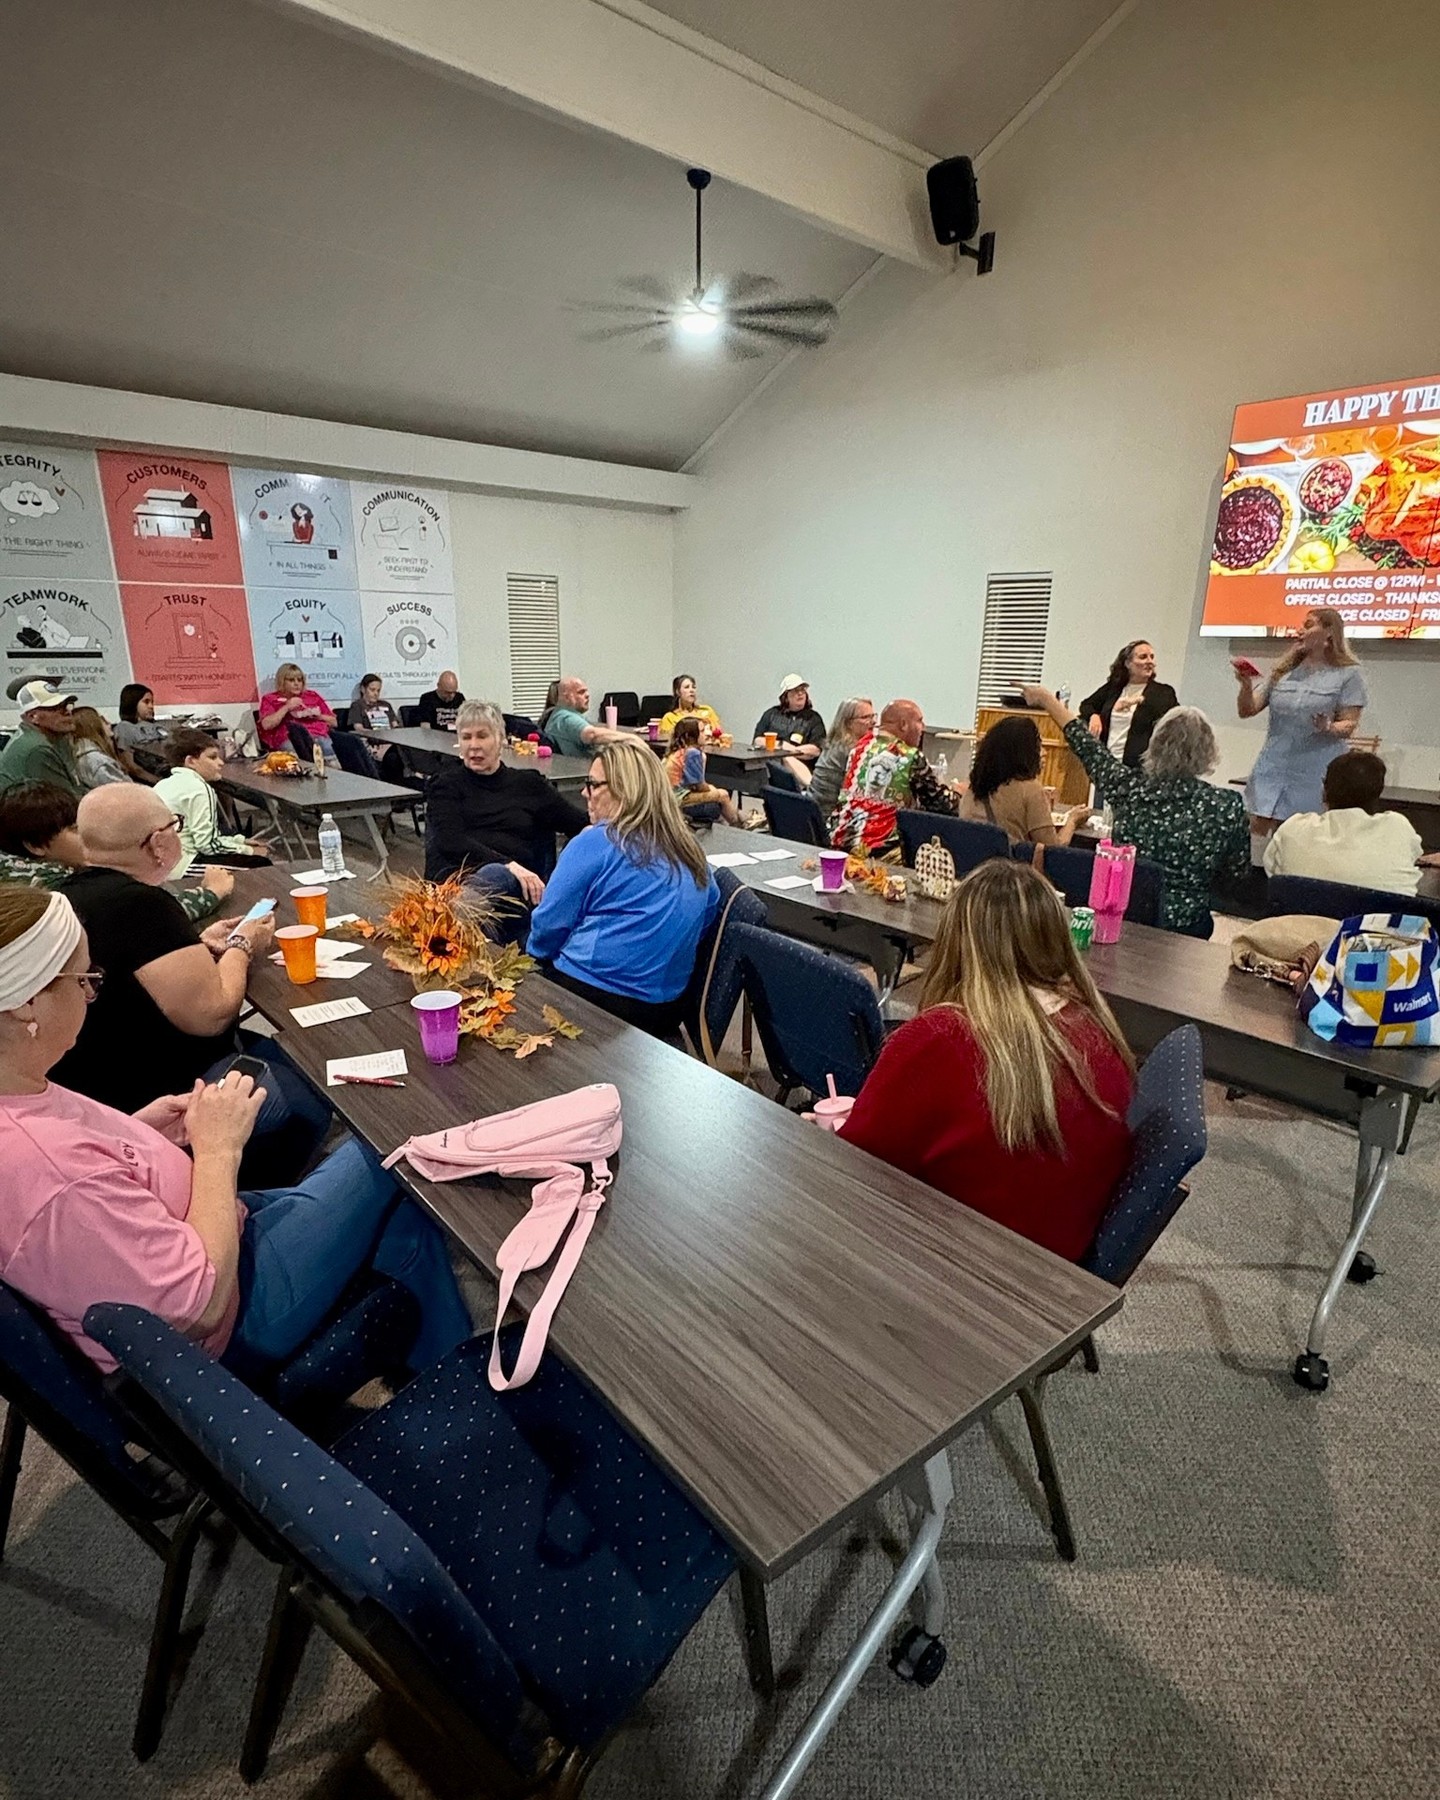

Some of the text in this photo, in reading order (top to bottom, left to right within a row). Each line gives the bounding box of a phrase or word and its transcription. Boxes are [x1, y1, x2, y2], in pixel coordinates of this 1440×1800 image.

[1302, 390, 1400, 427] HAPPY
[126, 464, 208, 490] CUSTOMERS
[362, 490, 440, 522] COMMUNICATION
[285, 561, 298, 569] ALL
[1285, 577, 1332, 590] PARTIAL
[1332, 576, 1373, 589] CLOSE
[1389, 574, 1426, 588] 12PM
[3, 589, 89, 611] TEAMWORK
[163, 594, 207, 606] TRUST
[285, 599, 327, 610] EQUITY
[1284, 593, 1326, 606] OFFICE
[1326, 592, 1375, 605] CLOSED
[1384, 591, 1440, 605] THANKS
[386, 601, 432, 616] SUCCESS
[1359, 609, 1411, 622] CLOSED
[1393, 991, 1432, 1013] Walmart
